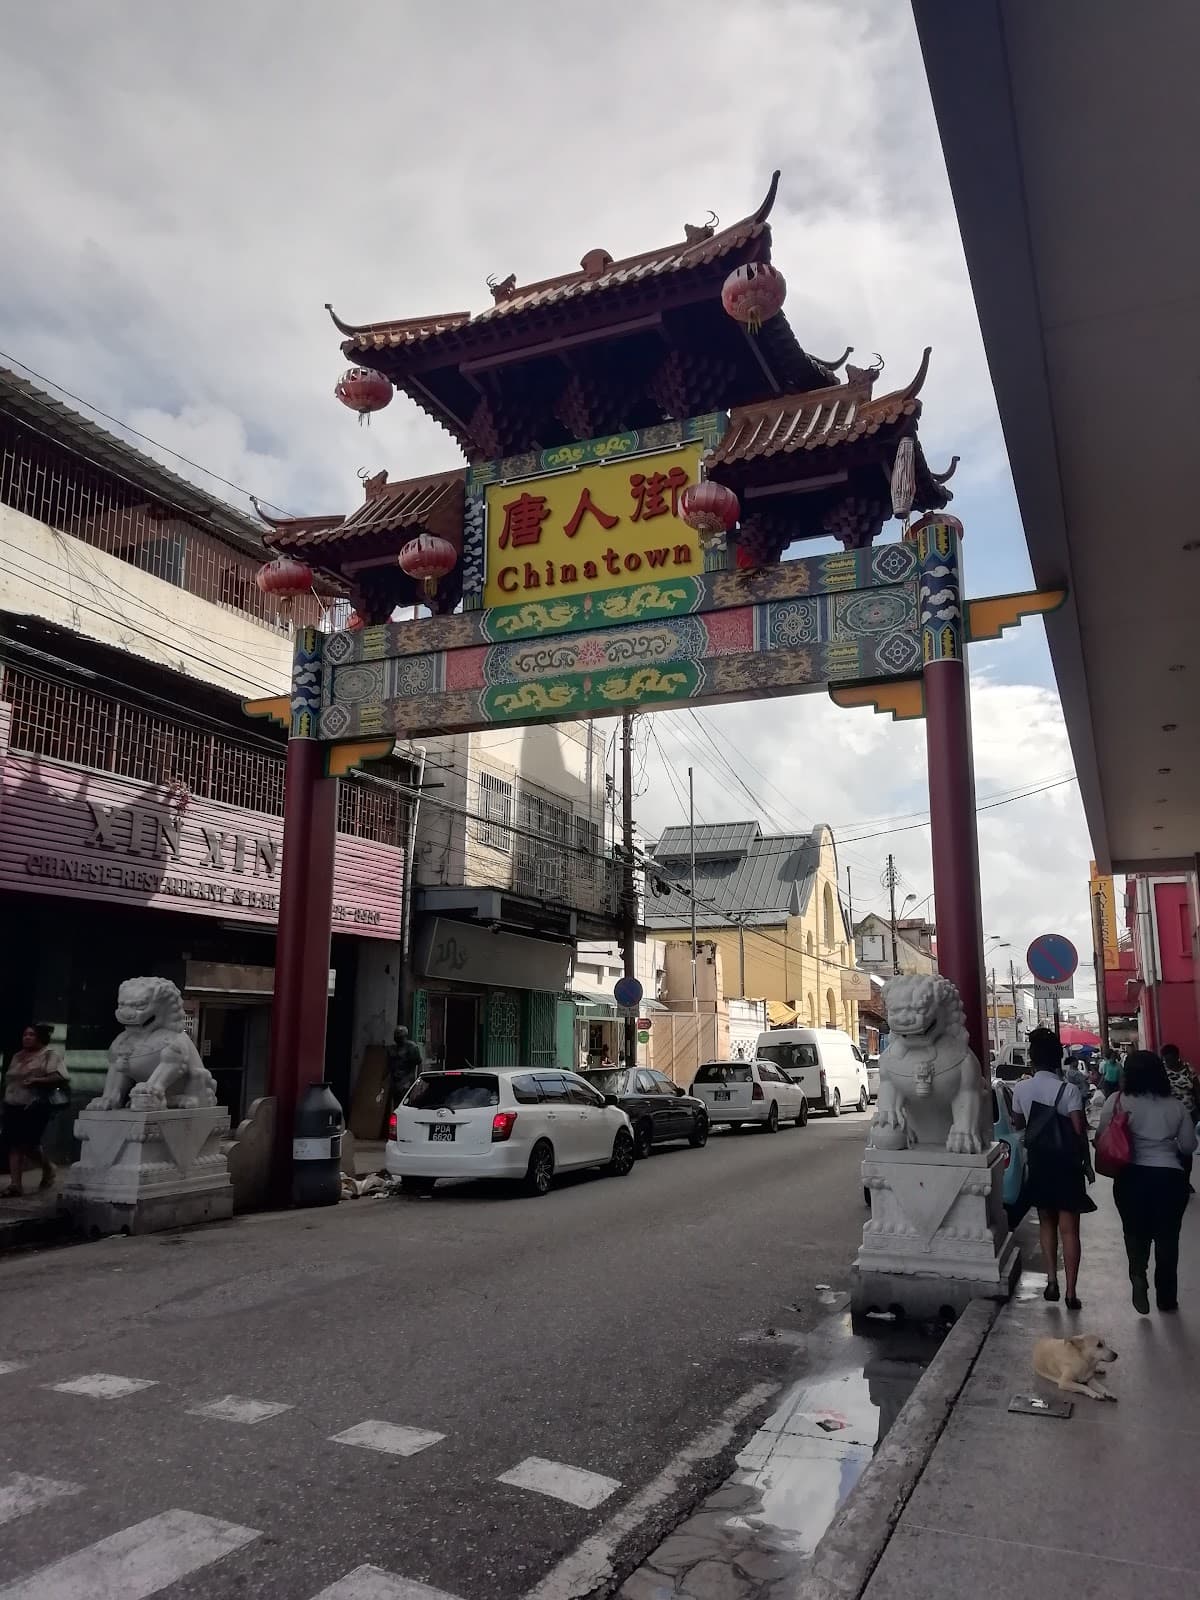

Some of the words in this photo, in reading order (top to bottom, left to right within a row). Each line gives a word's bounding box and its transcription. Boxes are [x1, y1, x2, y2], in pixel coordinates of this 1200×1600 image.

[498, 466, 688, 550] 唐人街
[497, 543, 692, 593] Chinatown
[84, 800, 184, 861] XIN
[199, 826, 278, 879] XIN
[26, 854, 111, 886] CHINESE
[121, 869, 227, 903] RESTAURANT
